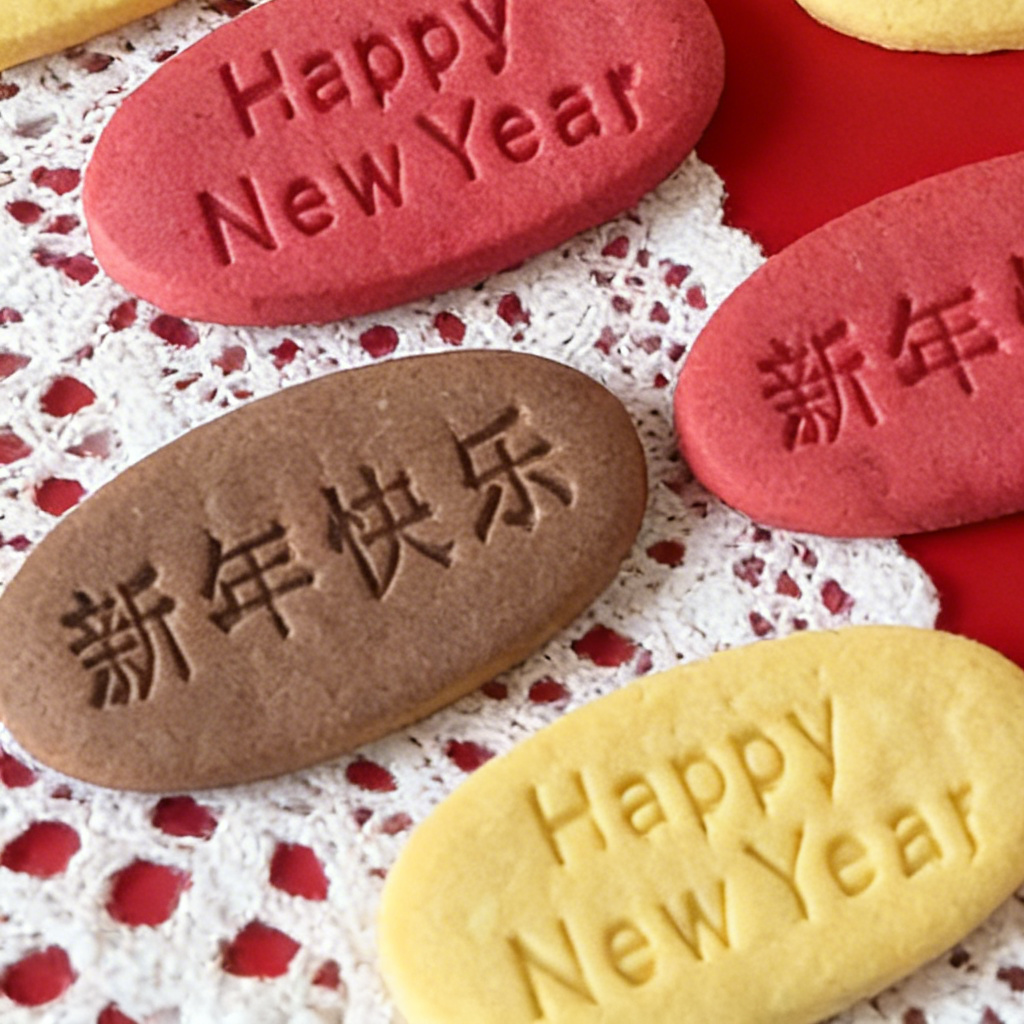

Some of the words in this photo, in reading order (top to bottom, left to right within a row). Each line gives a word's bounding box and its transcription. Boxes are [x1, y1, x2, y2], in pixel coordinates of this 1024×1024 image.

[197, 143, 403, 266] New
[417, 61, 642, 182] Year
[60, 406, 574, 710] 新年快乐
[528, 698, 838, 867] Happy
[507, 881, 733, 1020] New
[744, 783, 980, 920] Year
